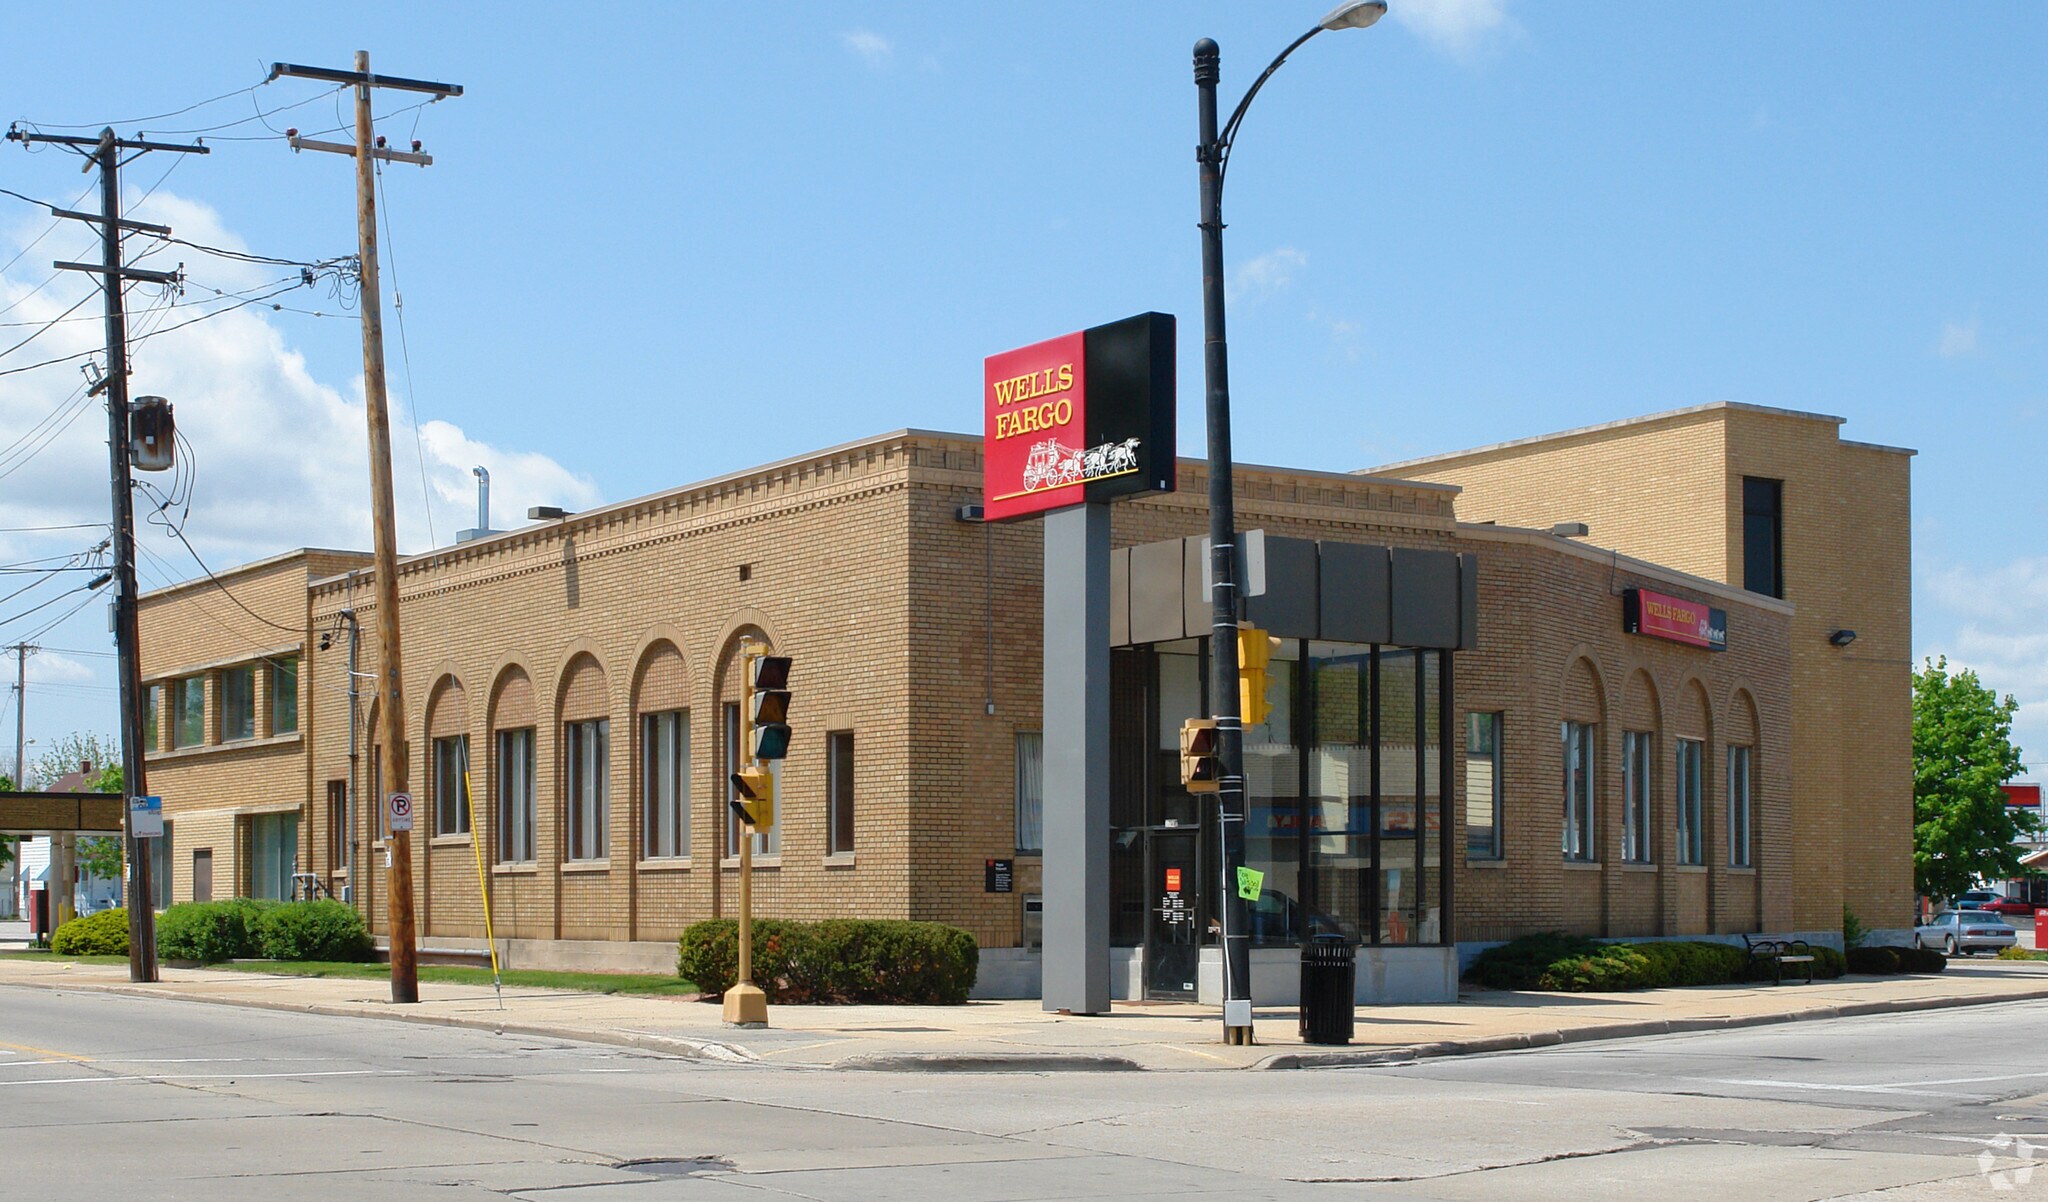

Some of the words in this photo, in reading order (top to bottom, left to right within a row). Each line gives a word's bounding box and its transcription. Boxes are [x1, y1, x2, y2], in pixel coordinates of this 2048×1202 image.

[993, 363, 1074, 406] WELLS
[995, 398, 1073, 440] FARGO
[1646, 601, 1672, 618] WELLS
[1672, 608, 1696, 624] FARGO
